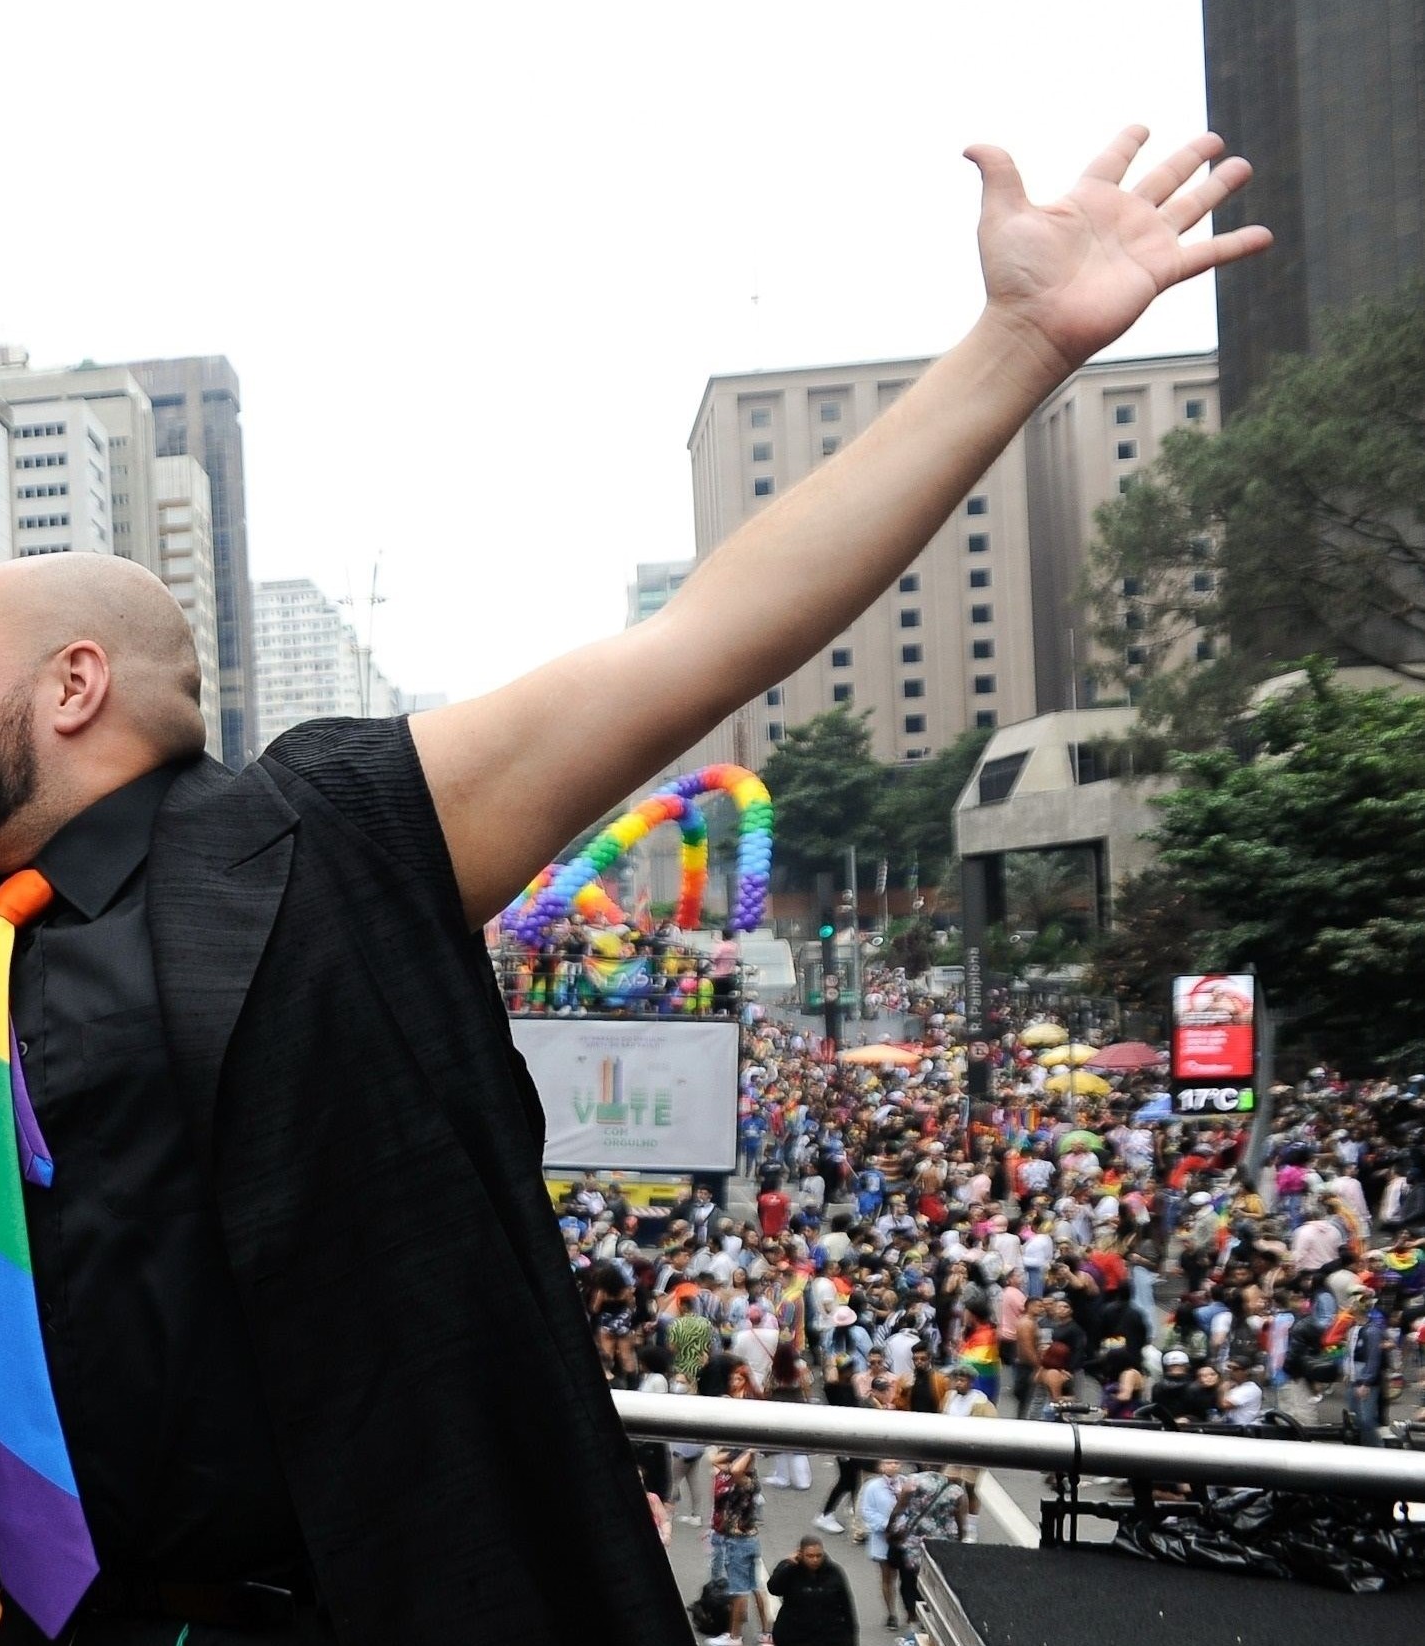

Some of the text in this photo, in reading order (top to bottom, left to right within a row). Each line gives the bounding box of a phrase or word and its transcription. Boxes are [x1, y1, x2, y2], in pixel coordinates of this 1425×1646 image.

[968, 947, 983, 1016] Pamplona
[572, 1092, 671, 1126] VTE
[1177, 1087, 1239, 1111] 17°C
[603, 1138, 659, 1148] ORGULHO
